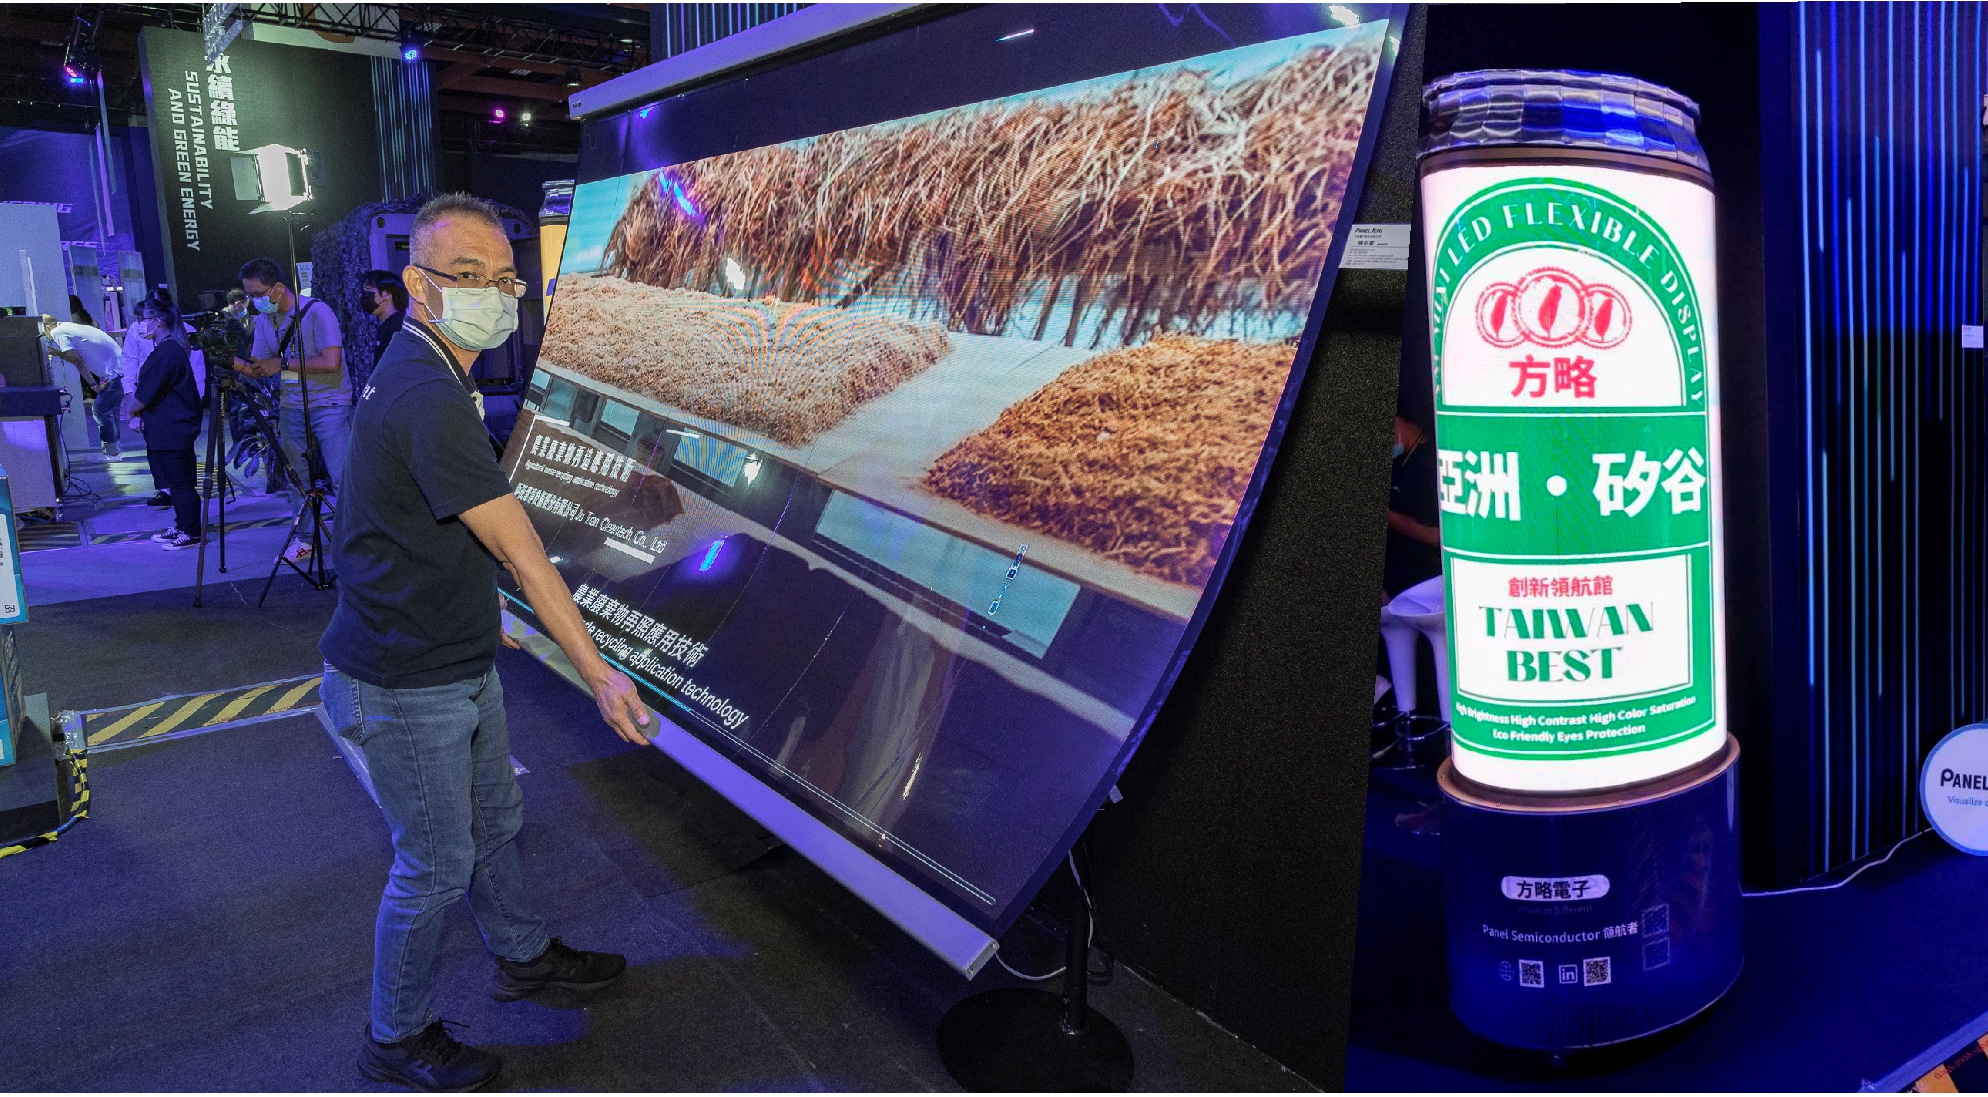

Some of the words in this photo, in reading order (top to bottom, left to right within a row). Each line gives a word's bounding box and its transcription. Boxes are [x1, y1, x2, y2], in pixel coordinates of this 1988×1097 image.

[168, 88, 185, 124] AND
[173, 129, 192, 182] GREEN
[185, 70, 213, 209] SUSTAINABILITY
[180, 187, 200, 251] ENERGY
[1447, 216, 1492, 267] LED
[1503, 202, 1660, 269] FLEXIBLE
[1660, 270, 1704, 406] DISPLAY
[1508, 354, 1597, 398] 方略
[1438, 449, 1521, 521] 亞洲
[1592, 447, 1706, 518] 矽谷
[1508, 575, 1613, 598] 創新領航館
[1478, 601, 1654, 640] TAIWAN
[592, 629, 634, 660] recycling
[629, 649, 685, 690] application
[680, 679, 750, 730] technology
[1506, 646, 1623, 682] BEST
[1467, 707, 1509, 722] Brightness
[1510, 714, 1536, 728] High
[1538, 715, 1587, 726] Contrast
[1589, 711, 1616, 725] High
[1617, 708, 1648, 720] Color
[1649, 695, 1696, 716] Saturation
[1510, 730, 1555, 744] Friendly
[1557, 731, 1583, 744] Eyes
[1586, 724, 1646, 740] Protection
[1940, 768, 1988, 791] PANEL
[1517, 880, 1591, 899] 方略電子
[1483, 924, 1509, 940] Panel
[1511, 930, 1601, 944] Semiconductor
[1602, 921, 1639, 940] 領航者
